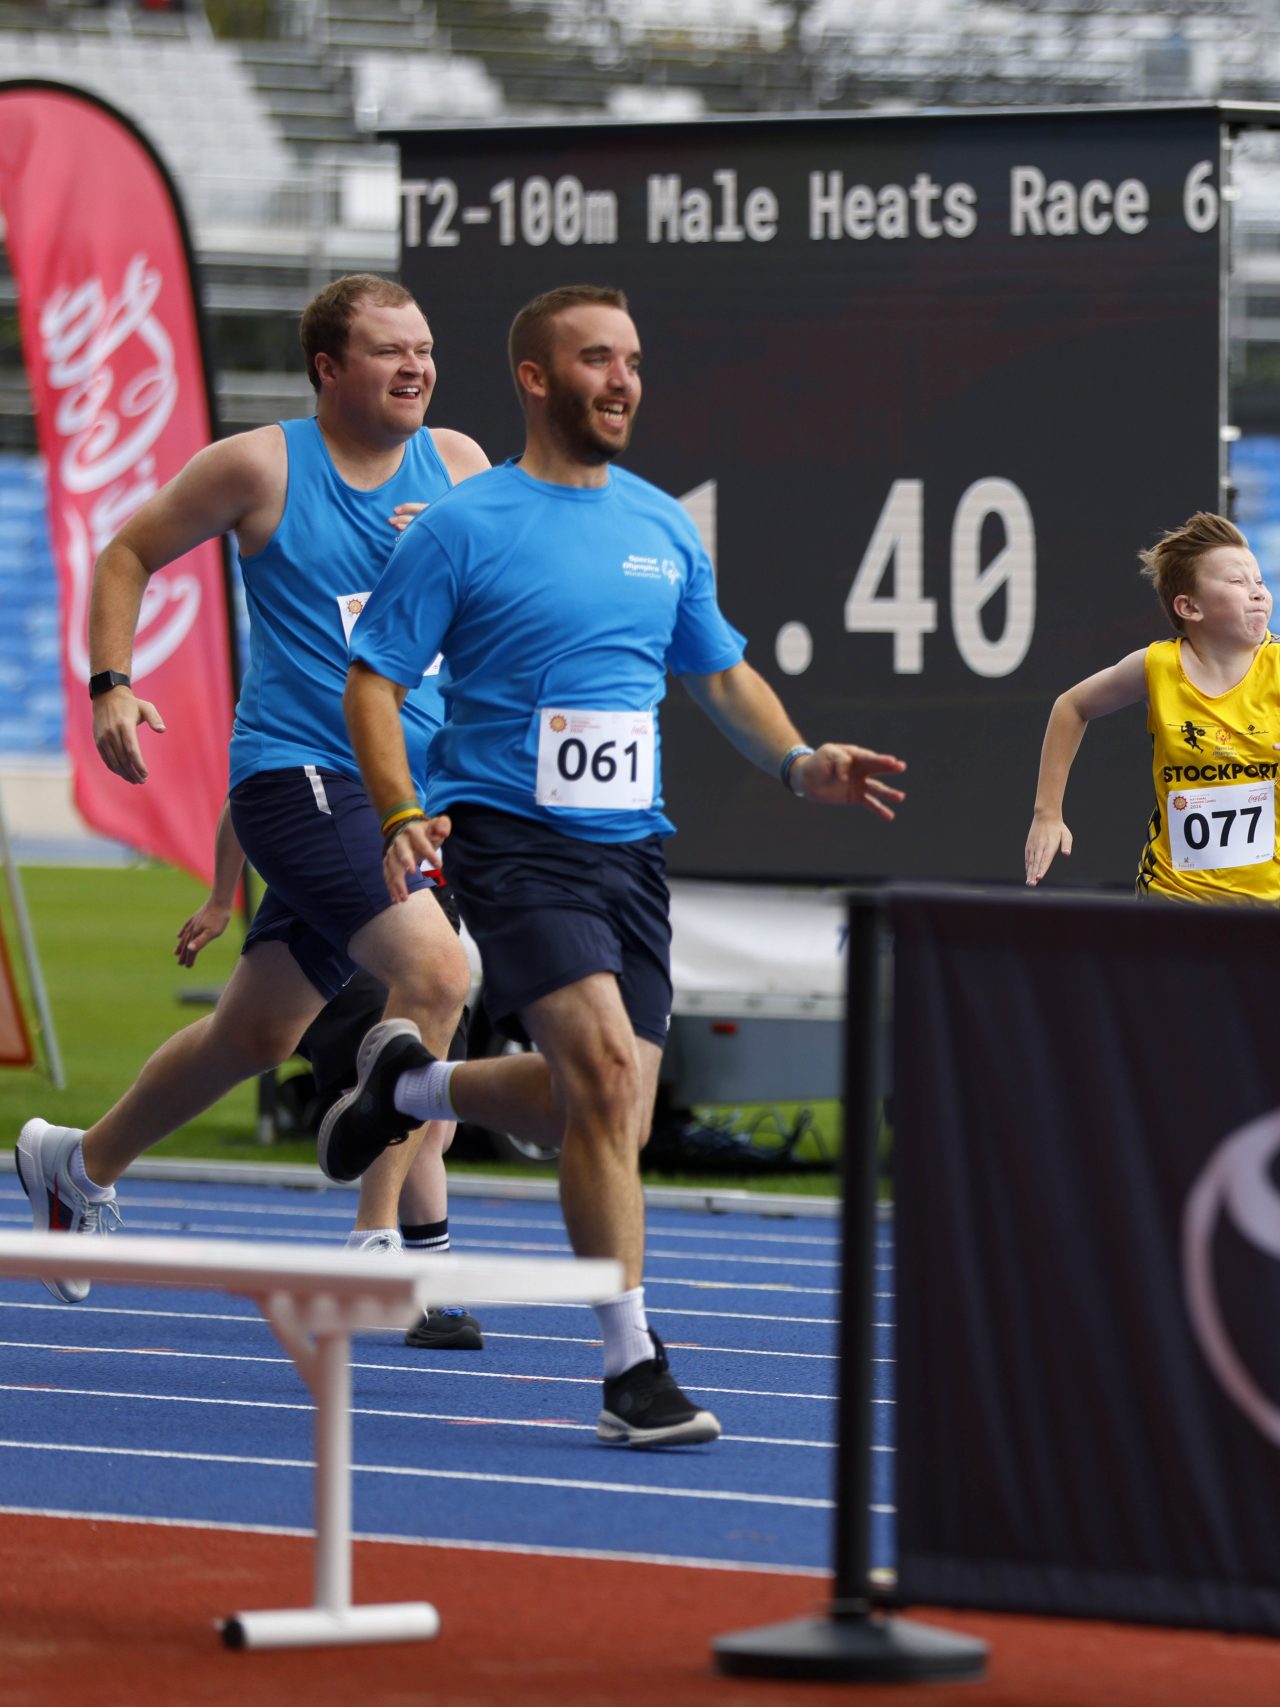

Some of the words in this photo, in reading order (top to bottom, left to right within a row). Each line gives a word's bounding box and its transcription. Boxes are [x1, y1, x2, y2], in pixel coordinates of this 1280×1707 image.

[399, 175, 618, 247] T2-100m
[647, 168, 779, 243] Male
[809, 169, 978, 240] Heats
[1010, 164, 1150, 236] Race
[1183, 159, 1219, 233] 6
[557, 738, 638, 783] 061
[1163, 762, 1279, 783] STOCKPORT
[1184, 806, 1262, 850] 077
